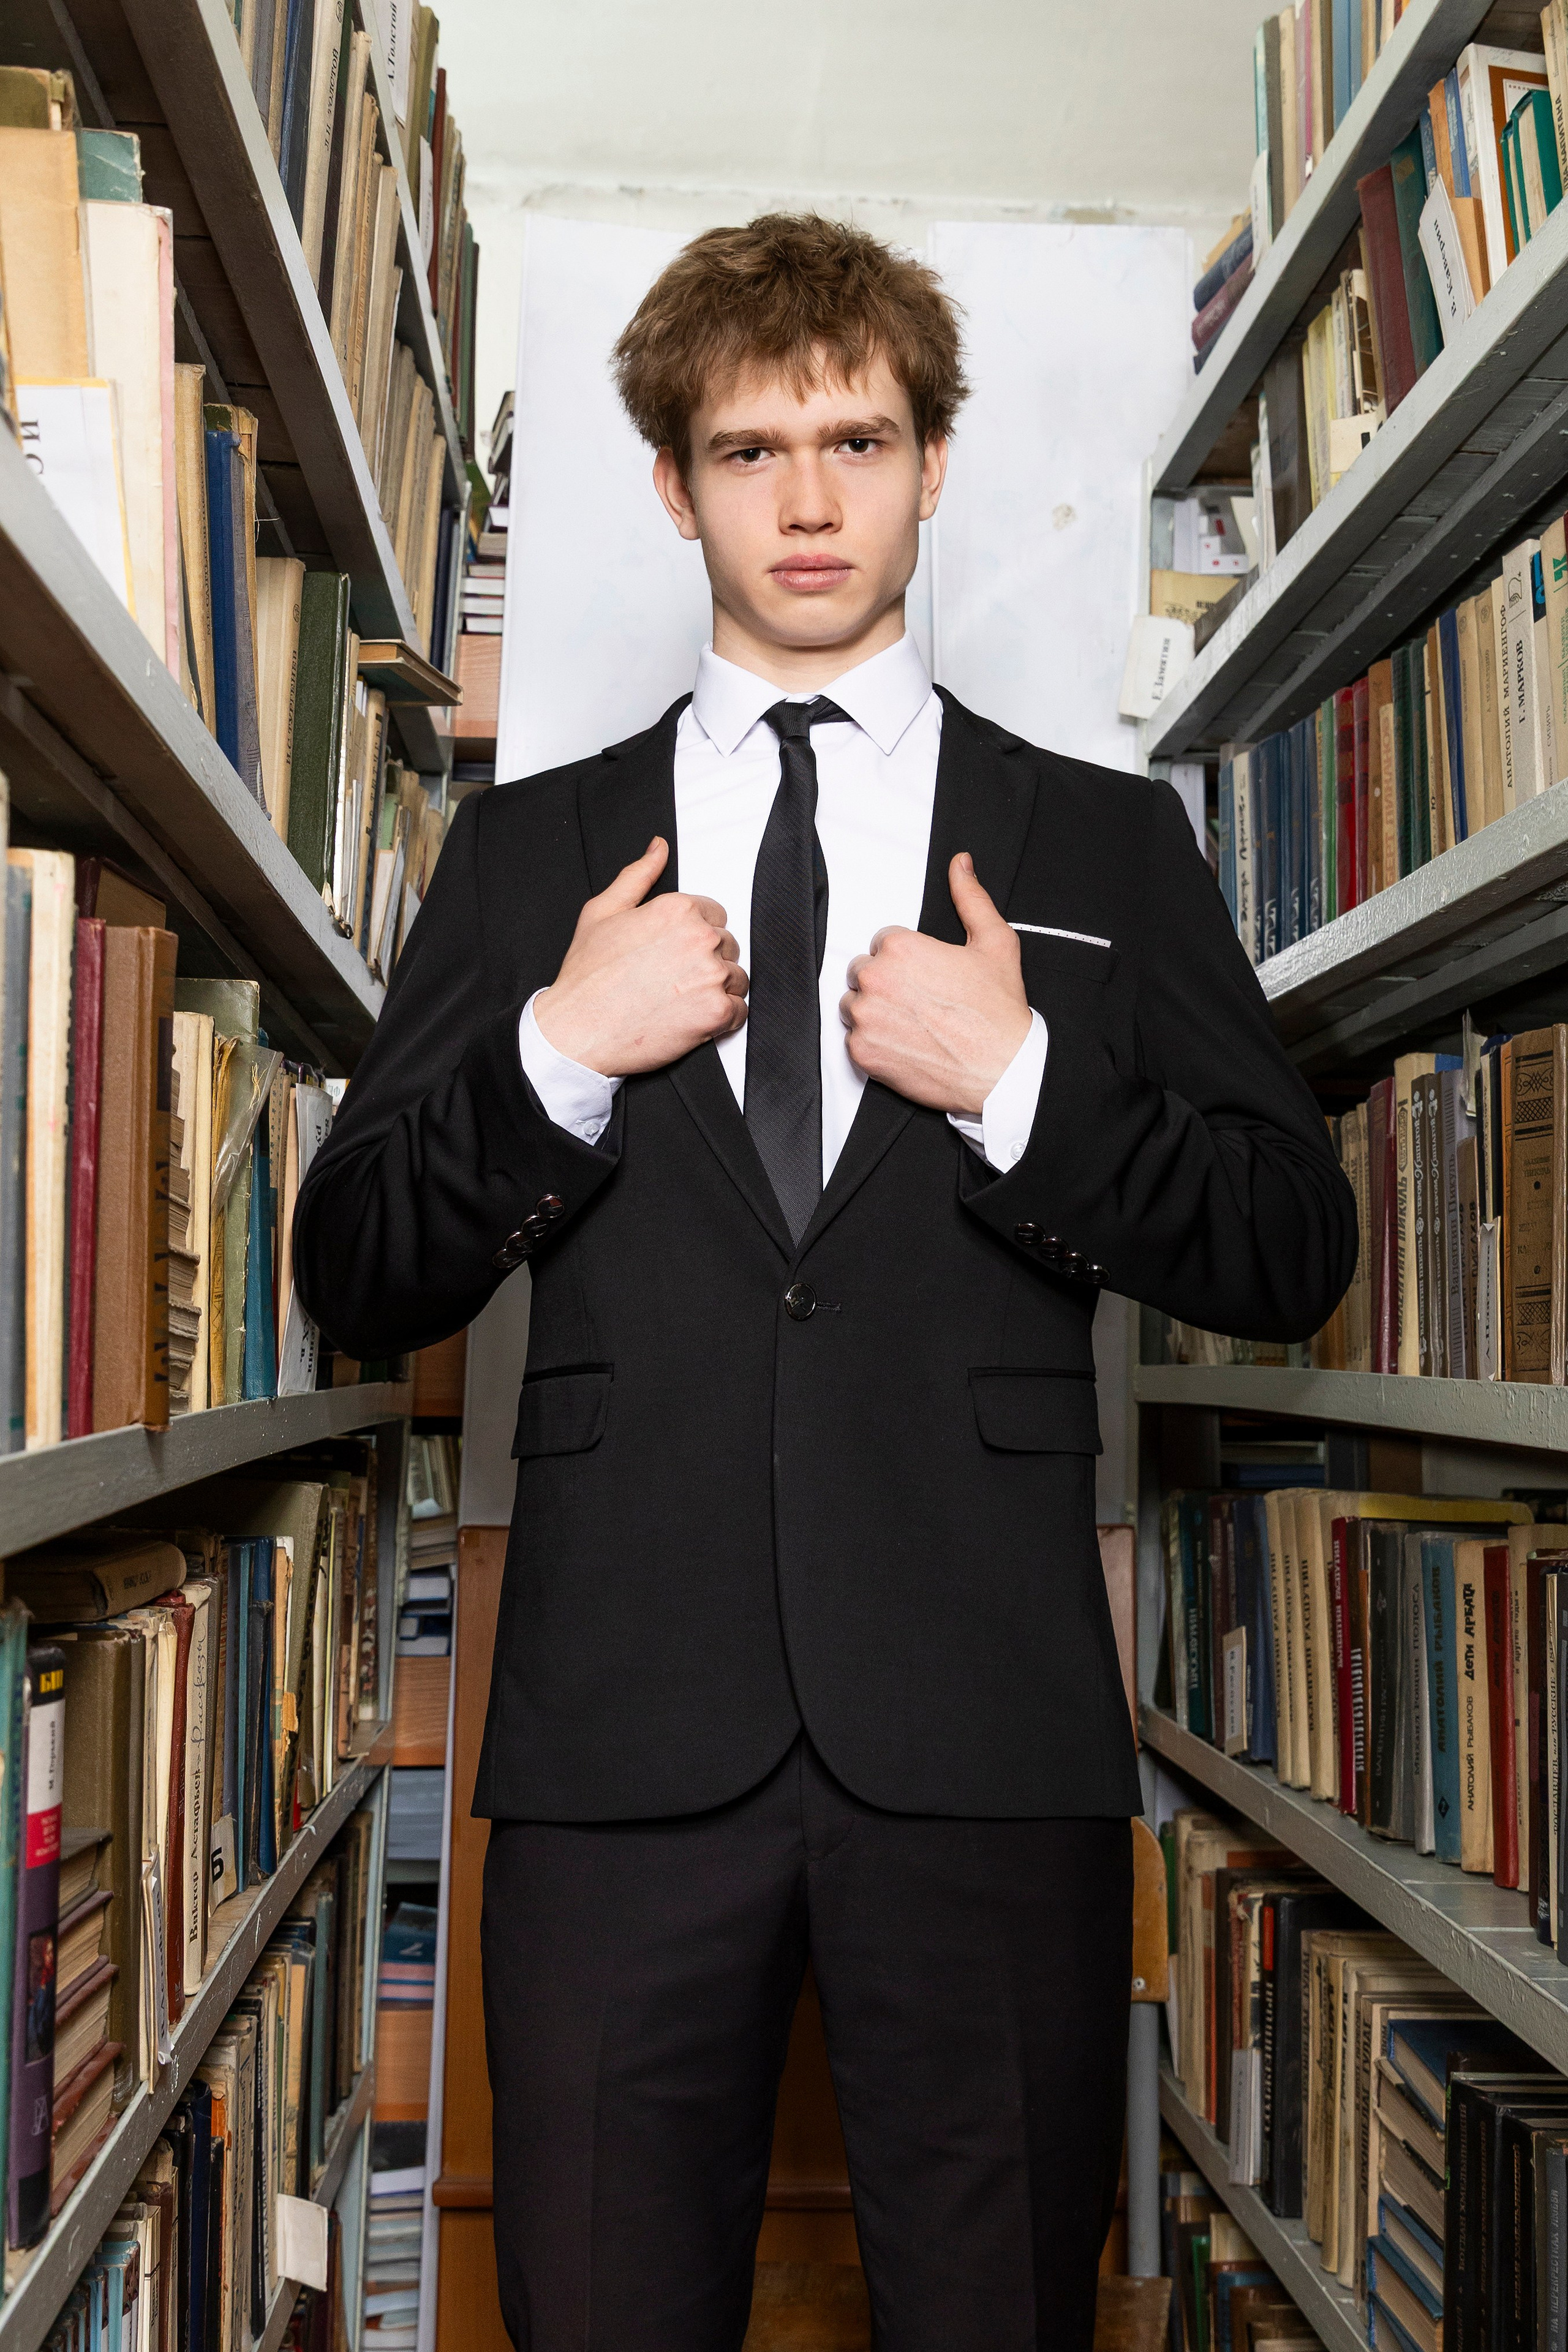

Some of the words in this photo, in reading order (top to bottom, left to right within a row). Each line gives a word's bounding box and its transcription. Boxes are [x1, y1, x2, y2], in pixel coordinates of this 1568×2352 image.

[388, 1, 397, 67] Толстой
[327, 48, 339, 115] ТОЛСТОЙ
[1556, 94, 1568, 164] КАПИТАНА
[1434, 219, 1453, 295] Каверин
[1501, 603, 1509, 699] МАРИЕНГОФ
[1516, 639, 1525, 709] МАРКОВ
[287, 650, 297, 734] ТУРГЕНЕВ
[1518, 709, 1524, 724] Г.
[1503, 706, 1513, 789] АНАТОЛИЙ
[1397, 1176, 1407, 1242] ПИКУЛЬ
[1448, 1152, 1457, 1213] Пикуль
[1449, 1218, 1459, 1295] Валентин
[1300, 1559, 1310, 1639] РАСПУТИН
[1333, 1539, 1342, 1599] РАСПУТИН
[1432, 1566, 1443, 1652] РЫБАКОВ
[1463, 1582, 1476, 1638] АРБАТА
[190, 1624, 208, 1747] Рассказы
[1434, 1660, 1447, 1753] АНАТОЛИЙ
[190, 1768, 202, 1861] Астафьев
[211, 1846, 225, 1879] Б
[189, 1871, 202, 1944] Виктор
[1362, 2018, 1371, 2075] ГУЛАГ
[1360, 2084, 1371, 2194] АРХИПЕЛАГ
[1551, 2189, 1559, 2227] ЛЮБВИ
[1550, 2232, 1559, 2312] ПЕРЕКРЕСТКАХ
[1549, 2318, 1558, 2333] НА
